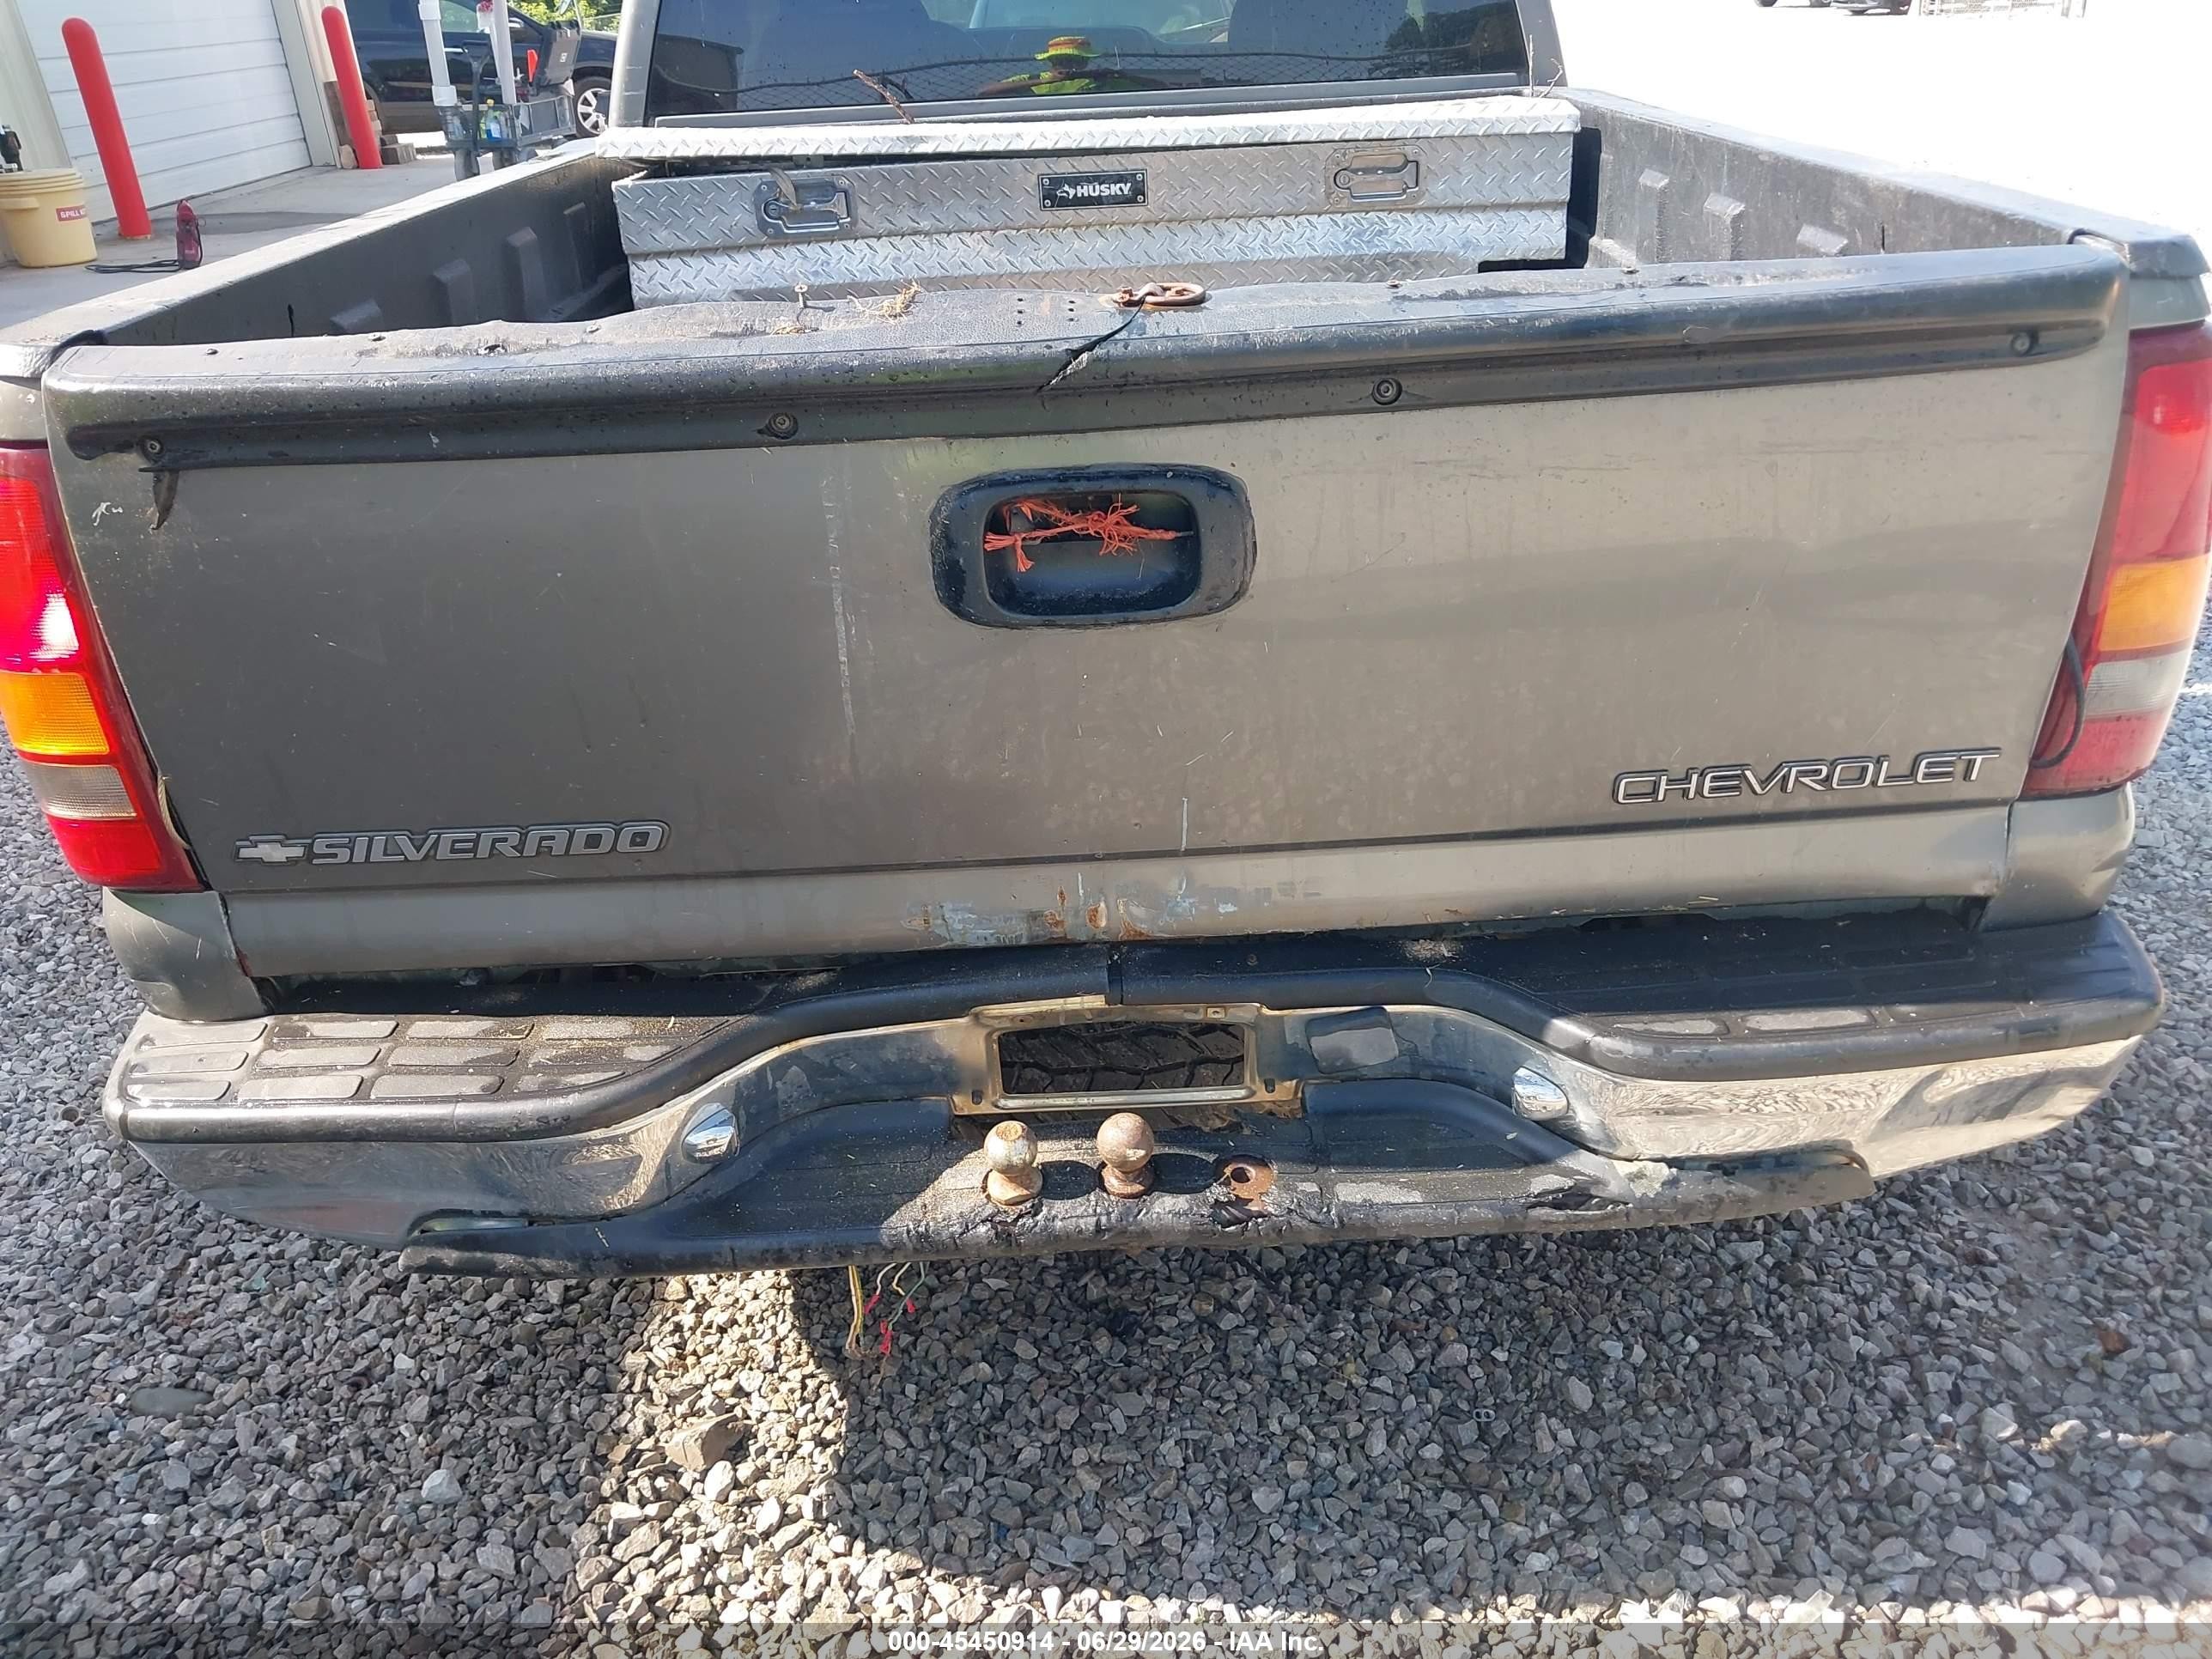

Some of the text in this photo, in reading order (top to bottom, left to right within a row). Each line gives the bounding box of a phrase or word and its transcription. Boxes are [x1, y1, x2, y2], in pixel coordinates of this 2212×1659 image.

[1076, 183, 1132, 198] HUSKY
[1613, 747, 2001, 804] CHEVROLET
[311, 821, 669, 865] SILVERADO
